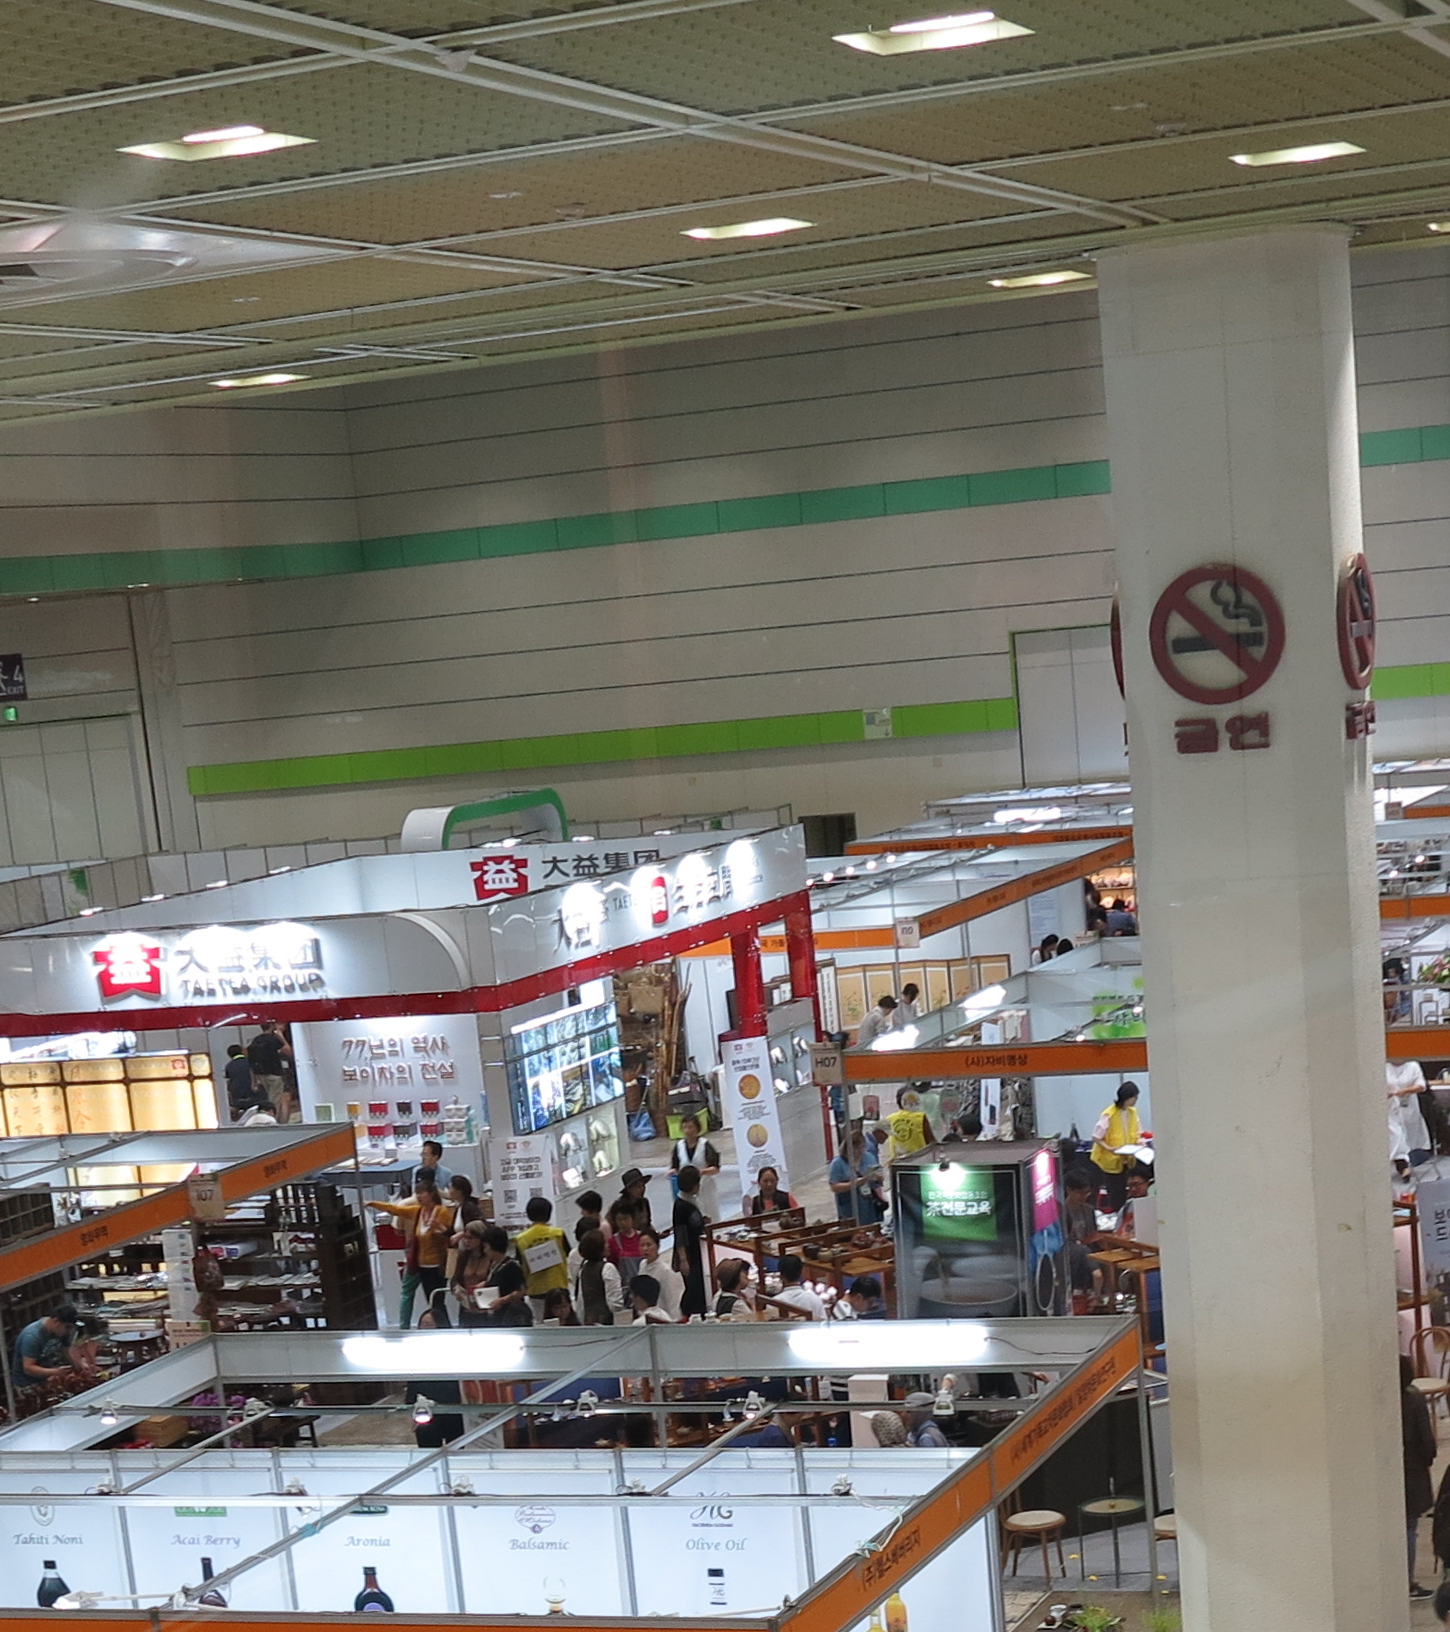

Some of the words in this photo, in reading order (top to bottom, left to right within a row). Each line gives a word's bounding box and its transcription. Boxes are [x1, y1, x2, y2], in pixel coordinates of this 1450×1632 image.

[12, 665, 24, 682] 4
[6, 684, 27, 695] EXIT
[1175, 711, 1271, 754] 금연
[256, 970, 324, 993] GROUP
[411, 1032, 449, 1057] 역사
[815, 1055, 838, 1069] H07
[341, 1063, 412, 1088] 보이차의
[419, 1058, 456, 1081] 전설
[12, 1532, 49, 1547] Tahiti
[50, 1532, 84, 1547] Noni
[170, 1534, 200, 1547] Acai
[204, 1533, 241, 1549] Berry
[343, 1535, 392, 1547] Aronia
[508, 1537, 571, 1551] Balsamic
[685, 1536, 722, 1553] Olive
[724, 1536, 749, 1552] Oil
